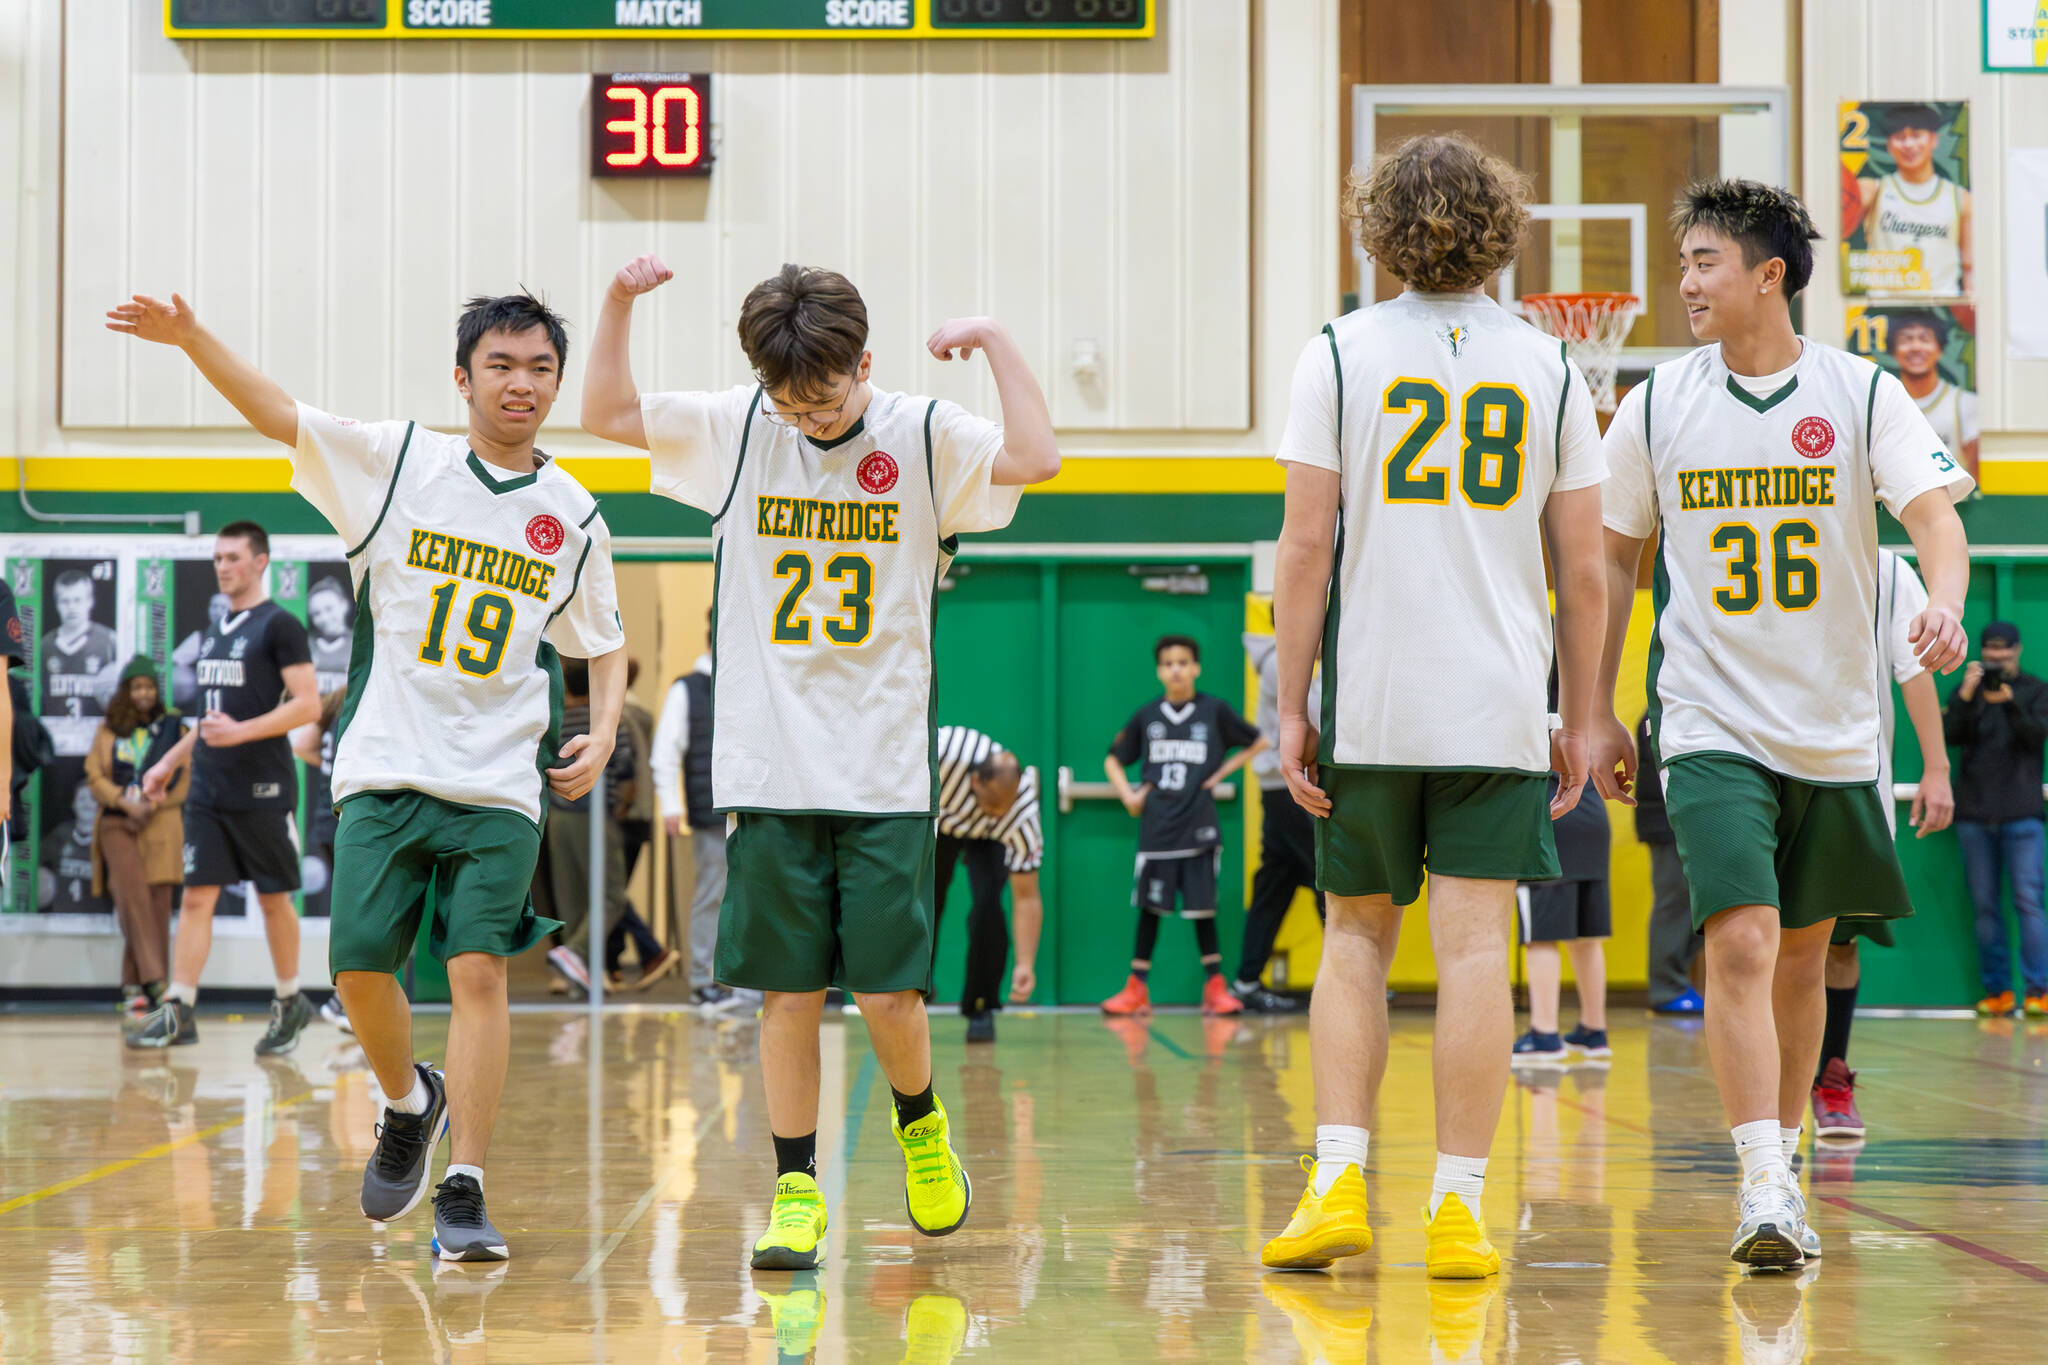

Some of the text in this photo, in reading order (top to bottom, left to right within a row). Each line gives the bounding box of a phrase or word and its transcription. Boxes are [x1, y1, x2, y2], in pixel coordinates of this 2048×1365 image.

[408, 0, 909, 26] SCORE MATCH SCORE
[604, 86, 699, 166] 30
[1843, 110, 1870, 149] 2
[1852, 314, 1889, 351] 11
[1382, 376, 1530, 511] 28
[757, 494, 900, 544] KENTRIDGE
[1677, 465, 1836, 511] KENTRIDGE
[405, 528, 557, 602] KENTRIDGE
[1709, 518, 1821, 616] 36
[417, 578, 516, 680] 19
[770, 549, 875, 647] 23
[1157, 763, 1188, 791] 13
